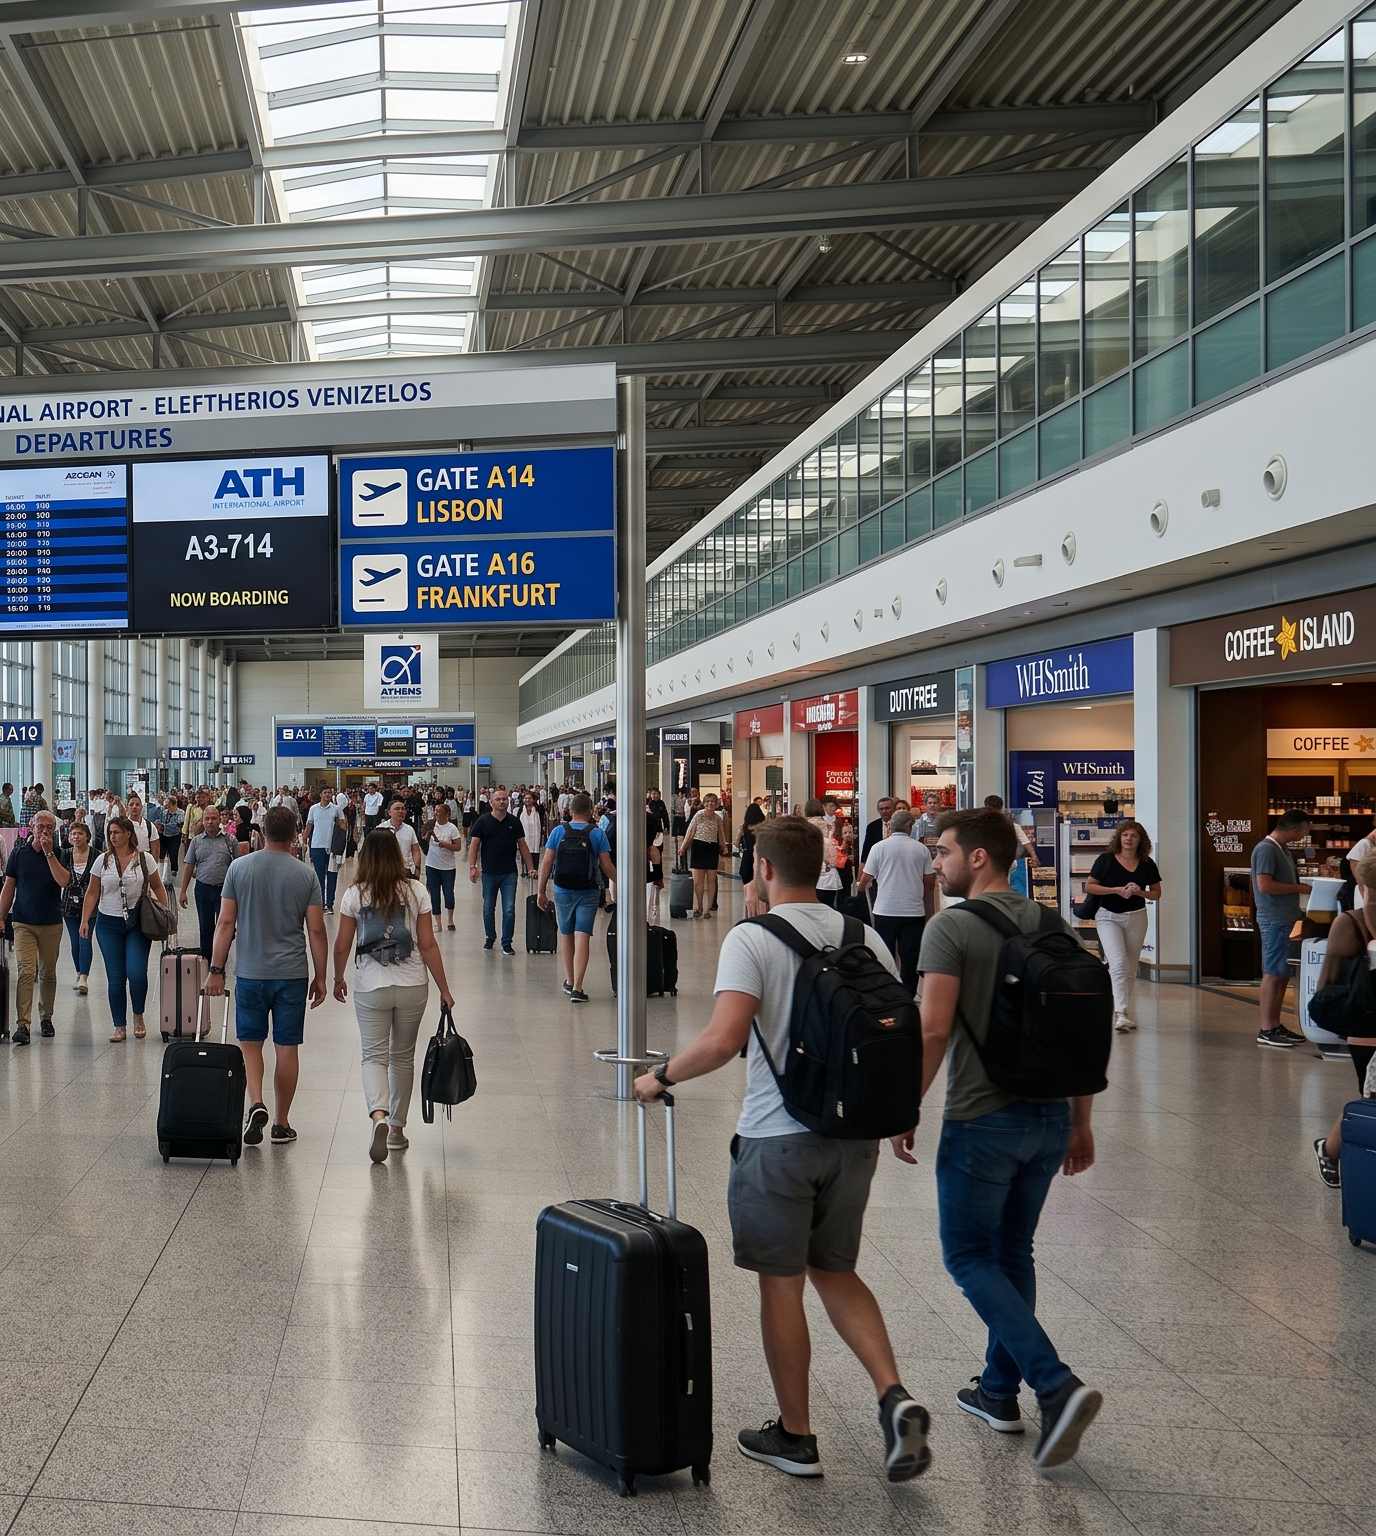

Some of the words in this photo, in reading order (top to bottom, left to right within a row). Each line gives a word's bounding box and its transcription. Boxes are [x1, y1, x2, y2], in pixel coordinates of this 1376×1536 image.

[39, 398, 133, 424] AIRPORT
[155, 389, 300, 416] ELEFTHERIOS
[307, 381, 432, 407] VENIZELOS
[15, 427, 173, 455] DEPARTURES
[213, 466, 305, 500] ATH
[416, 467, 479, 492] GATE
[486, 464, 535, 489] A14
[212, 500, 271, 510] INTERNATIONAL
[272, 499, 305, 507] AIRPORT
[417, 498, 503, 524] LISBON
[184, 532, 274, 561] A3-714
[416, 554, 479, 578] GATE
[487, 551, 535, 576] A16
[169, 592, 207, 608] NOW
[210, 589, 289, 607] BOARDING
[417, 583, 561, 609] FRANKFURT
[1225, 624, 1275, 662] COFFEE
[1299, 610, 1355, 652] ISLAND
[1015, 652, 1091, 699] WHSmith
[380, 687, 422, 696] ATHENS
[889, 687, 914, 713] DUTY
[913, 683, 938, 710] FREE
[295, 728, 317, 740] A12
[1292, 737, 1350, 751] COFFEE
[1062, 762, 1126, 775] WHSmith
